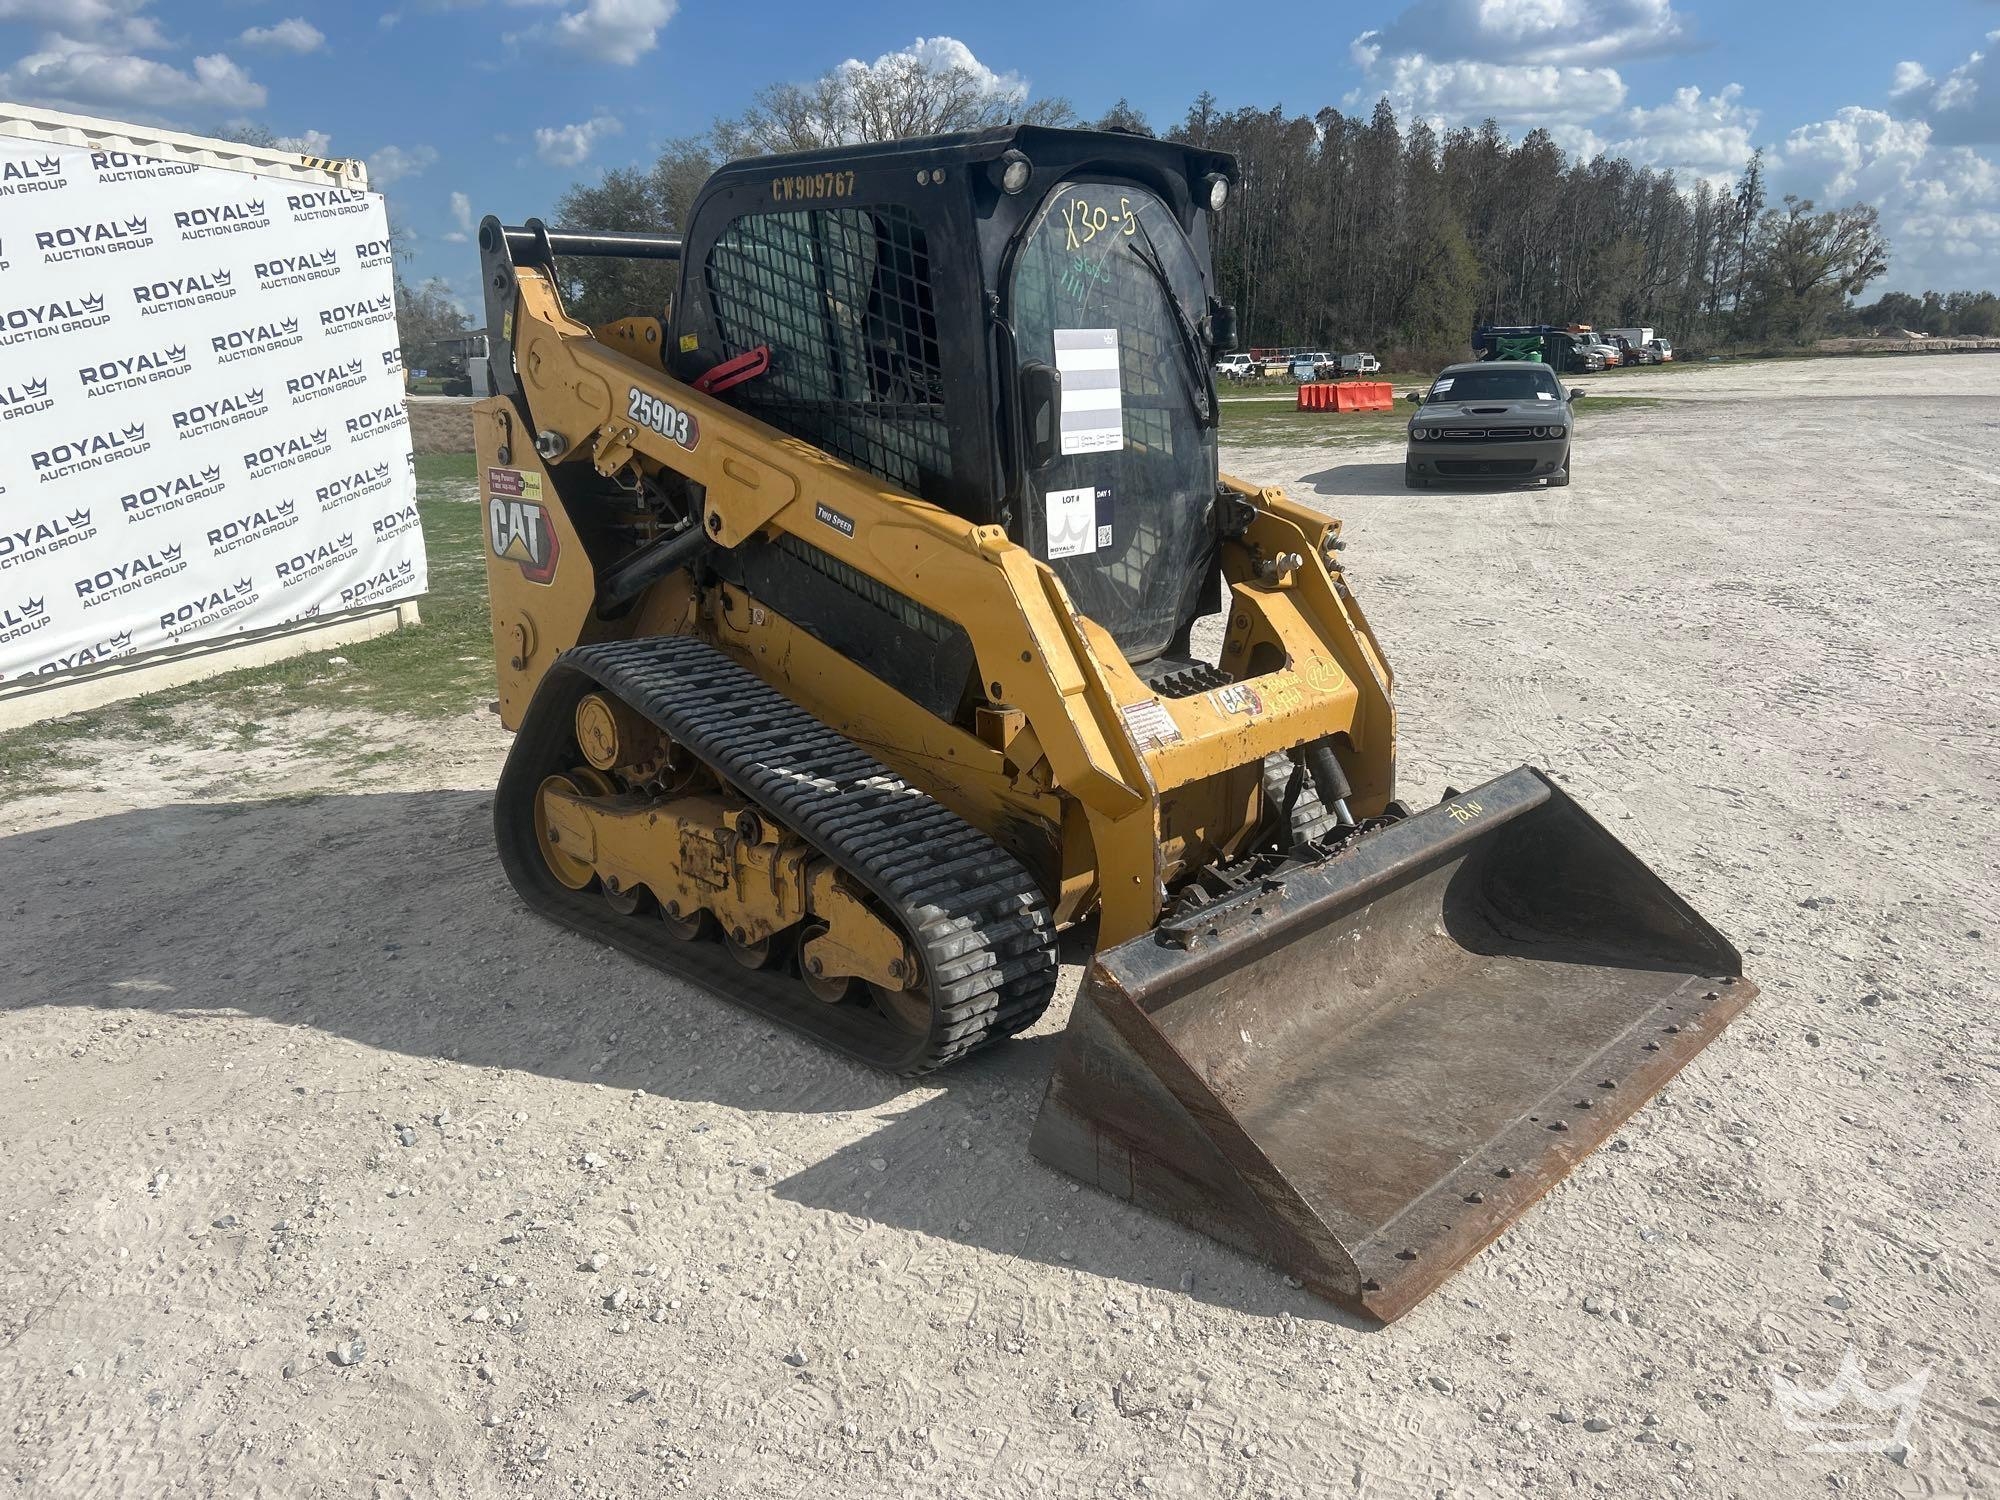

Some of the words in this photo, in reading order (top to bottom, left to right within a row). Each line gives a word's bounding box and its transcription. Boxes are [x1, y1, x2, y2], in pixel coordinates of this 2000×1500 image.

[17, 179, 67, 194] GROUP
[99, 168, 156, 184] AUCTION
[158, 164, 200, 176] GROUP
[772, 170, 856, 200] CW909767
[287, 190, 351, 210] ROYAL
[294, 208, 337, 222] AUCTION
[338, 204, 370, 216] GROUP
[174, 204, 249, 228] ROYAL
[182, 222, 232, 240] AUCTION
[233, 219, 270, 232] GROUP
[1062, 198, 1136, 250] X30-5
[35, 222, 128, 250] ROYAL
[44, 245, 106, 264] AUCTION
[108, 238, 154, 252] GROUP
[254, 254, 322, 279] ROYAL
[260, 274, 306, 290] AUCTION
[307, 268, 341, 281] GROUP
[133, 274, 214, 304] ROYAL
[141, 298, 196, 316] AUCTION
[197, 288, 236, 304] GROUP
[62, 314, 110, 332] GROUP
[320, 300, 379, 326] ROYAL
[325, 321, 364, 336] AUCTION
[364, 311, 394, 325] GROUP
[212, 323, 282, 352] ROYAL
[218, 346, 266, 364] AUCTION
[266, 335, 304, 352] GROUP
[79, 352, 168, 386] ROYAL
[87, 376, 147, 398] AUCTION
[149, 364, 192, 382] GROUP
[286, 365, 348, 394] ROYAL
[292, 386, 335, 406] AUCTION
[336, 376, 368, 392] GROUP
[3, 399, 54, 420] GROUP
[172, 396, 248, 429] ROYAL
[179, 416, 230, 440] AUCTION
[232, 406, 269, 424] GROUP
[346, 404, 402, 434] ROYAL
[628, 388, 689, 444] 259D3
[351, 424, 390, 443] AUCTION
[390, 416, 408, 429] GRO
[31, 432, 124, 470] ROYAL
[40, 456, 103, 484] AUCTION
[104, 442, 151, 464] GROUP
[244, 436, 312, 470] ROYAL
[250, 458, 296, 480] AUCTION
[297, 444, 332, 463] GROUP
[120, 474, 204, 512] ROYAL
[316, 470, 376, 502] ROYAL
[322, 490, 362, 512] AUCTION
[362, 478, 392, 496] GROUP
[1062, 496, 1074, 504] LOT
[1096, 490, 1108, 498] DAY
[128, 498, 184, 524] AUCTION
[186, 482, 226, 504] GROUP
[48, 528, 98, 552] GROUP
[207, 508, 278, 546] ROYAL
[214, 532, 262, 558] AUCTION
[262, 516, 299, 536] GROUP
[376, 522, 412, 544] AUCTION
[490, 498, 540, 564] CAT
[275, 541, 339, 578] ROYAL
[282, 564, 324, 588] AUCTION
[326, 548, 358, 568] GROUP
[74, 554, 163, 598] ROYAL
[82, 579, 142, 610] AUCTION
[144, 561, 188, 586] GROUP
[344, 588, 384, 610] AUCTION
[386, 574, 416, 594] GROUP
[160, 588, 236, 630] ROYAL
[166, 611, 220, 640] AUCTION
[220, 594, 260, 616] GROUP
[0, 616, 51, 644] GROUP
[1218, 685, 1250, 714] CAT
